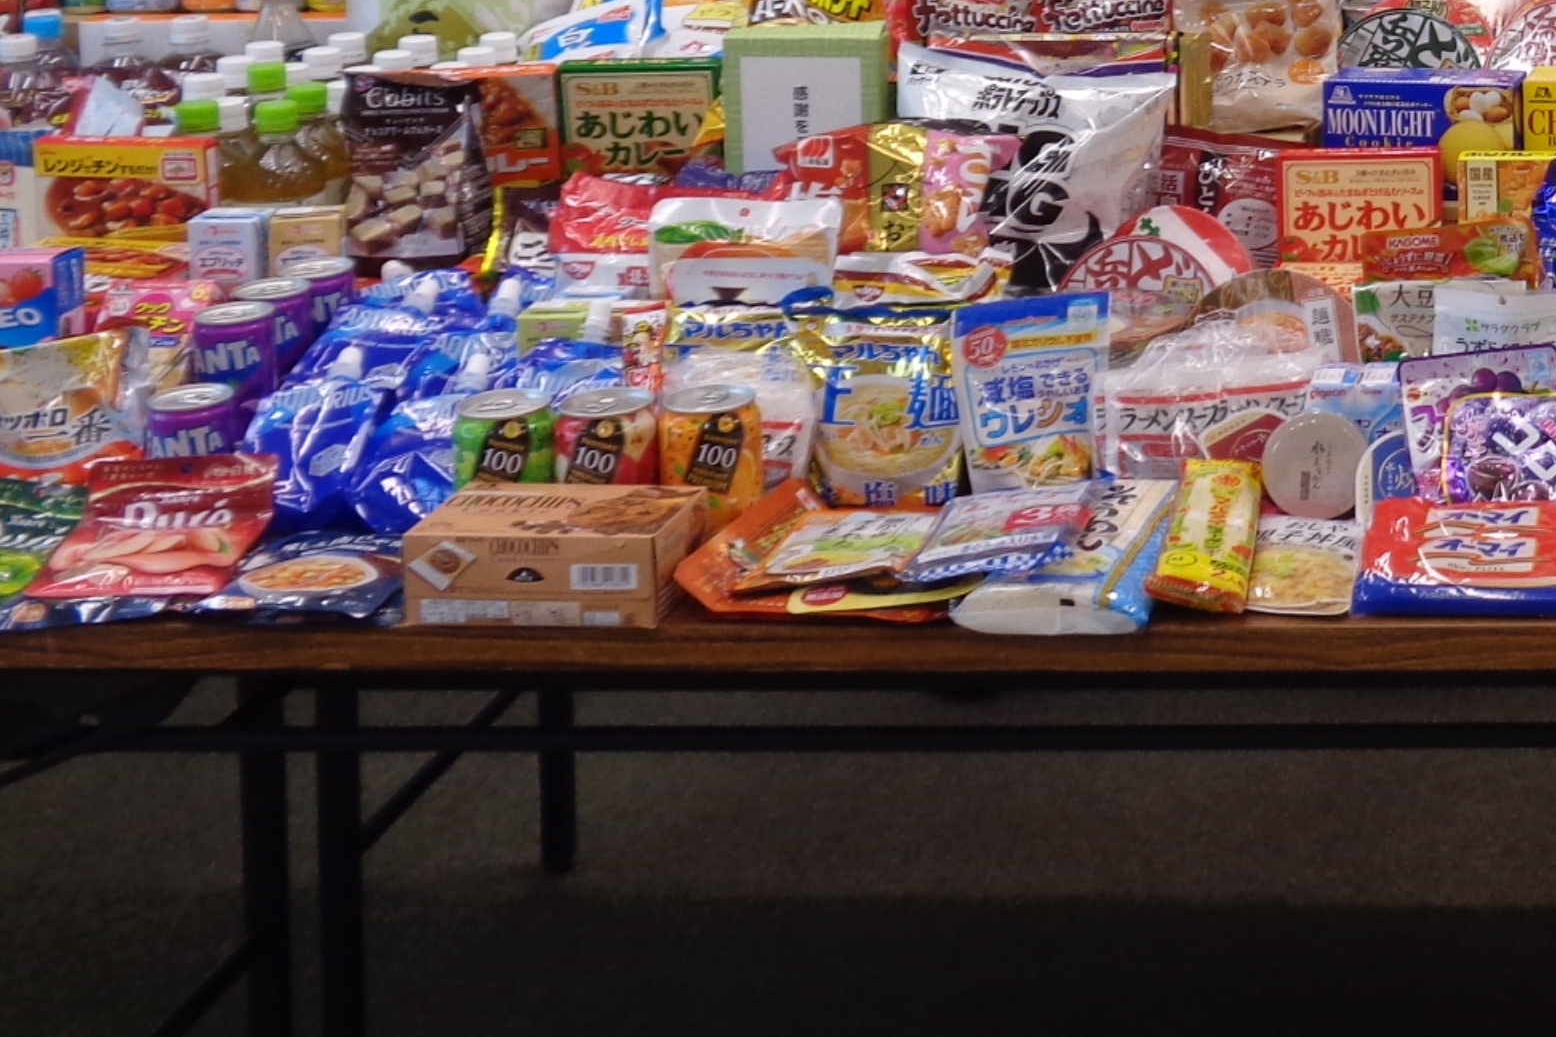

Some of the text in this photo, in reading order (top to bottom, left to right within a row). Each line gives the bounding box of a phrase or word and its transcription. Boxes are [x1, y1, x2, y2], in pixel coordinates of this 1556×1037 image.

[366, 86, 445, 108] Cubits
[575, 81, 619, 96] S&B
[575, 112, 701, 139] あじわい
[1327, 107, 1435, 138] MOONLIGHT
[603, 143, 687, 167] カレー
[1295, 170, 1340, 185] S&B
[1293, 201, 1428, 232] あじわい
[1388, 236, 1439, 249] KAGOME
[967, 336, 995, 360] 50
[1310, 388, 1347, 401] pigeon
[0, 410, 112, 445] ッポロ一番
[482, 448, 523, 473] 100
[575, 447, 616, 472] 100
[697, 443, 737, 467] 100
[489, 537, 560, 556] CHOCOCHIPS
[1432, 538, 1522, 557] オーマイ
